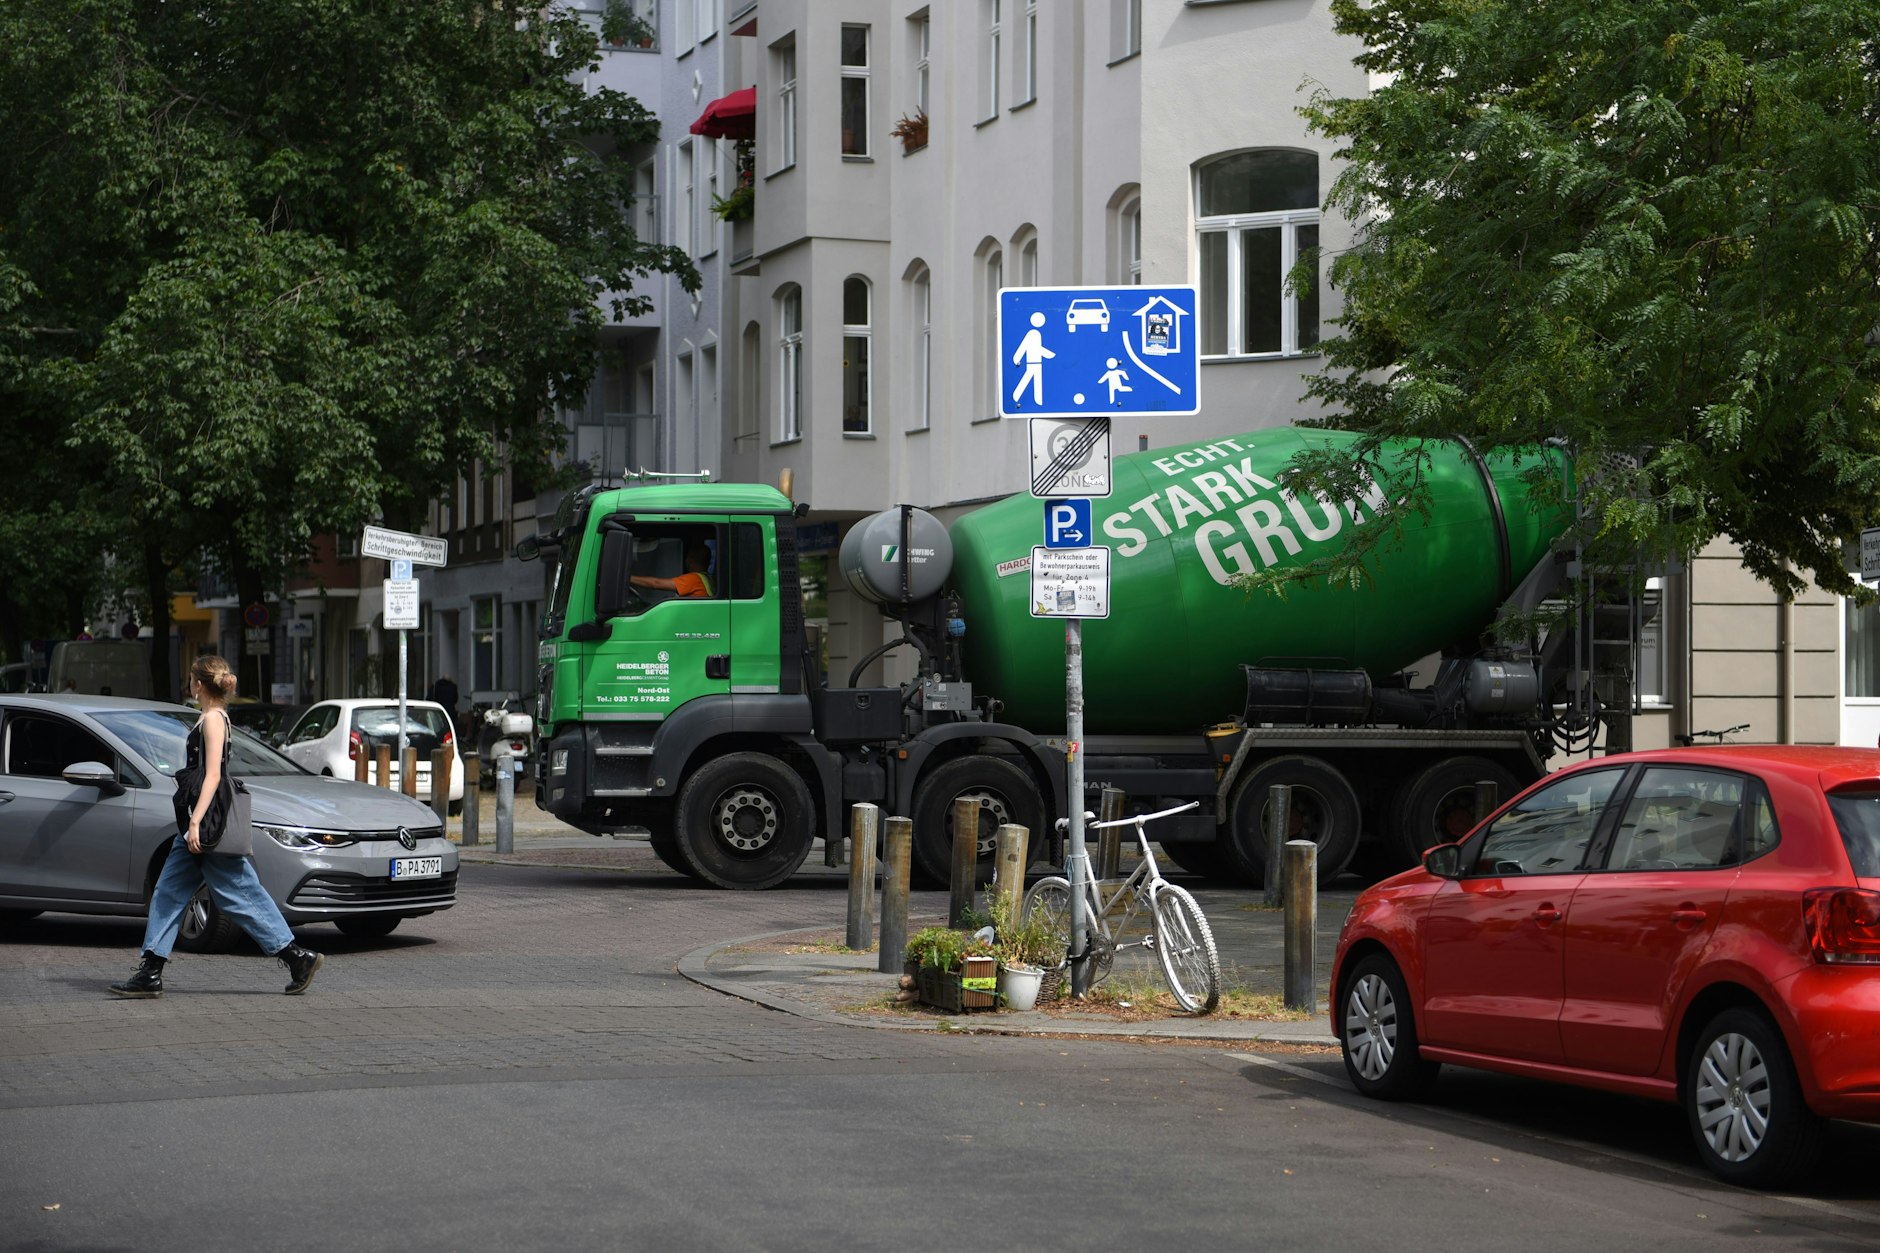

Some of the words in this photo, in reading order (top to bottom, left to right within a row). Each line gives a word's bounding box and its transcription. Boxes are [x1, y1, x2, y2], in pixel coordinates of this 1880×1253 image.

[1152, 438, 1255, 476] ECHT.
[1102, 457, 1278, 558] STARK
[1052, 506, 1076, 542] P
[366, 542, 441, 560] Schrittgeschwindigkeit
[368, 532, 418, 546] Verkehrsberuhigter
[420, 540, 442, 550] Bereich
[397, 862, 402, 875] B
[409, 861, 419, 874] PA
[421, 860, 440, 874] 3791
